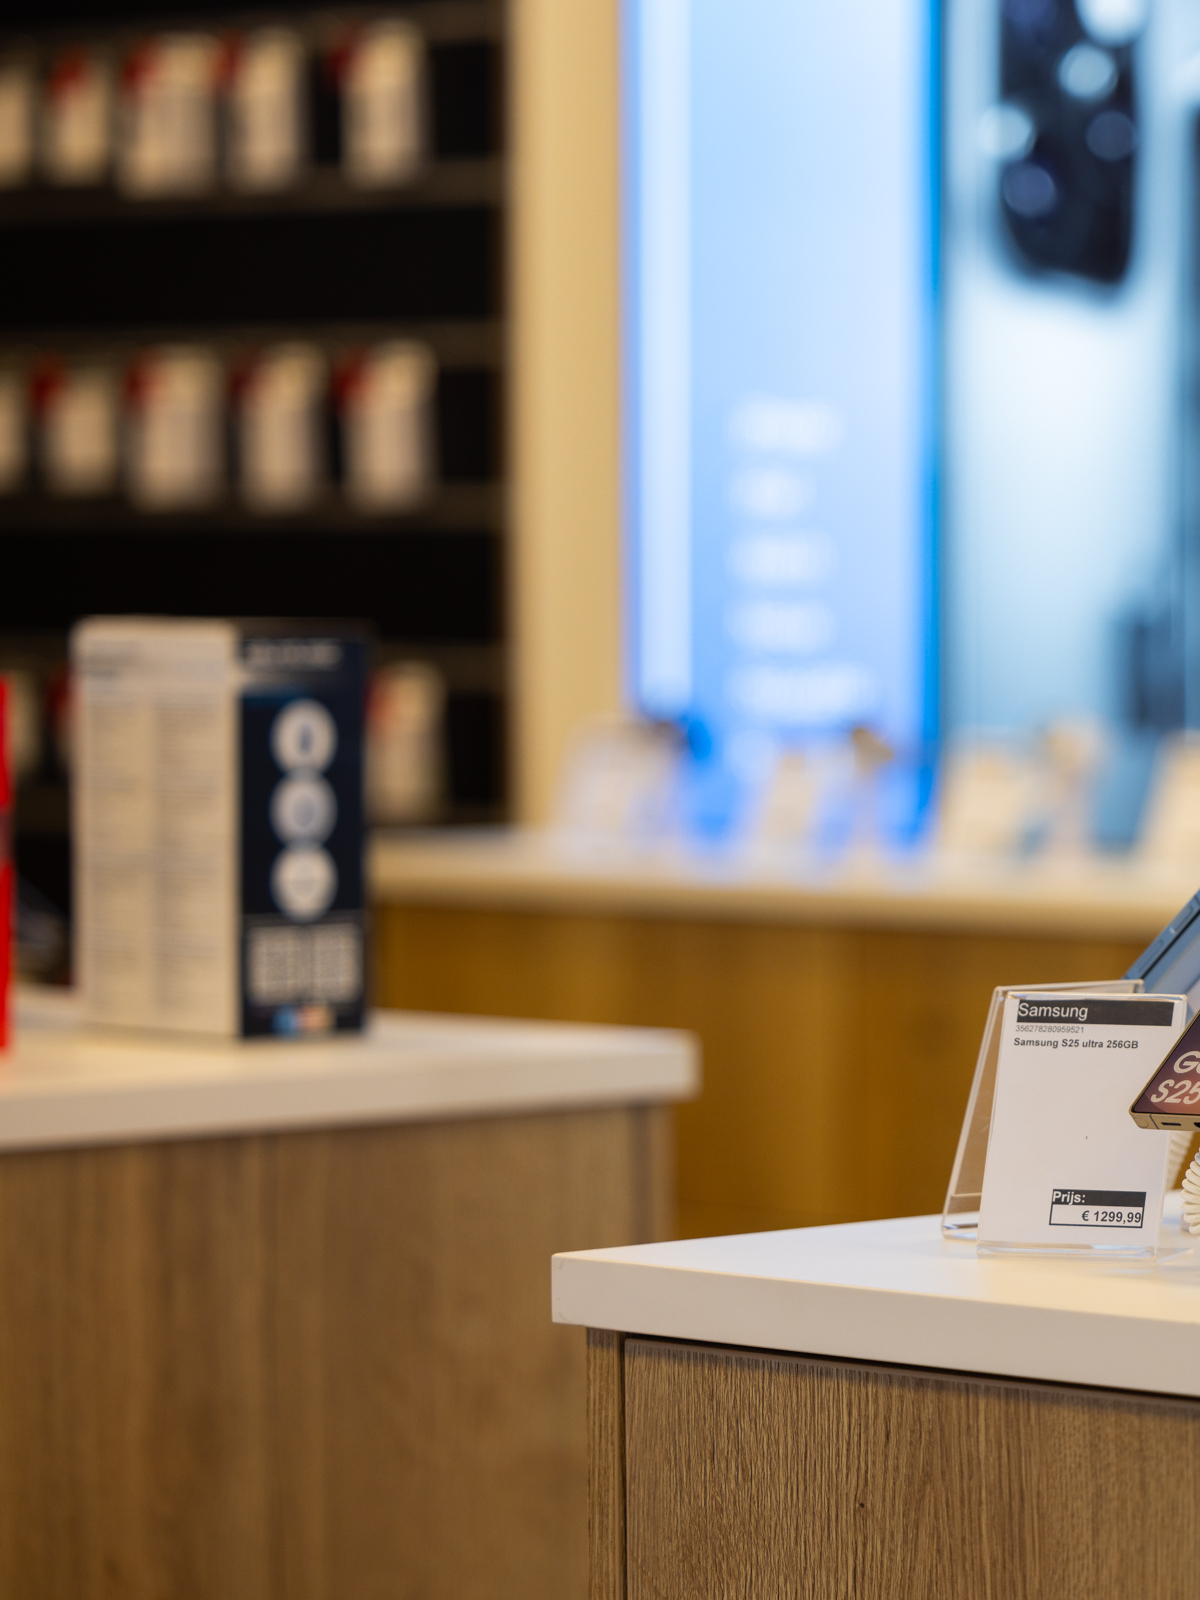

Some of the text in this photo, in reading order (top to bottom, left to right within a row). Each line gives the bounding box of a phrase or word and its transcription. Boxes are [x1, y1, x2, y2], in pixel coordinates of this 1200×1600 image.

[1018, 1003, 1088, 1021] Samsung
[1015, 1025, 1084, 1033] 356278280959521
[1014, 1037, 1138, 1049] Samsung S25 ultra 256GB
[1052, 1191, 1086, 1205] Prijs:
[1081, 1210, 1141, 1224] € 1299,99
